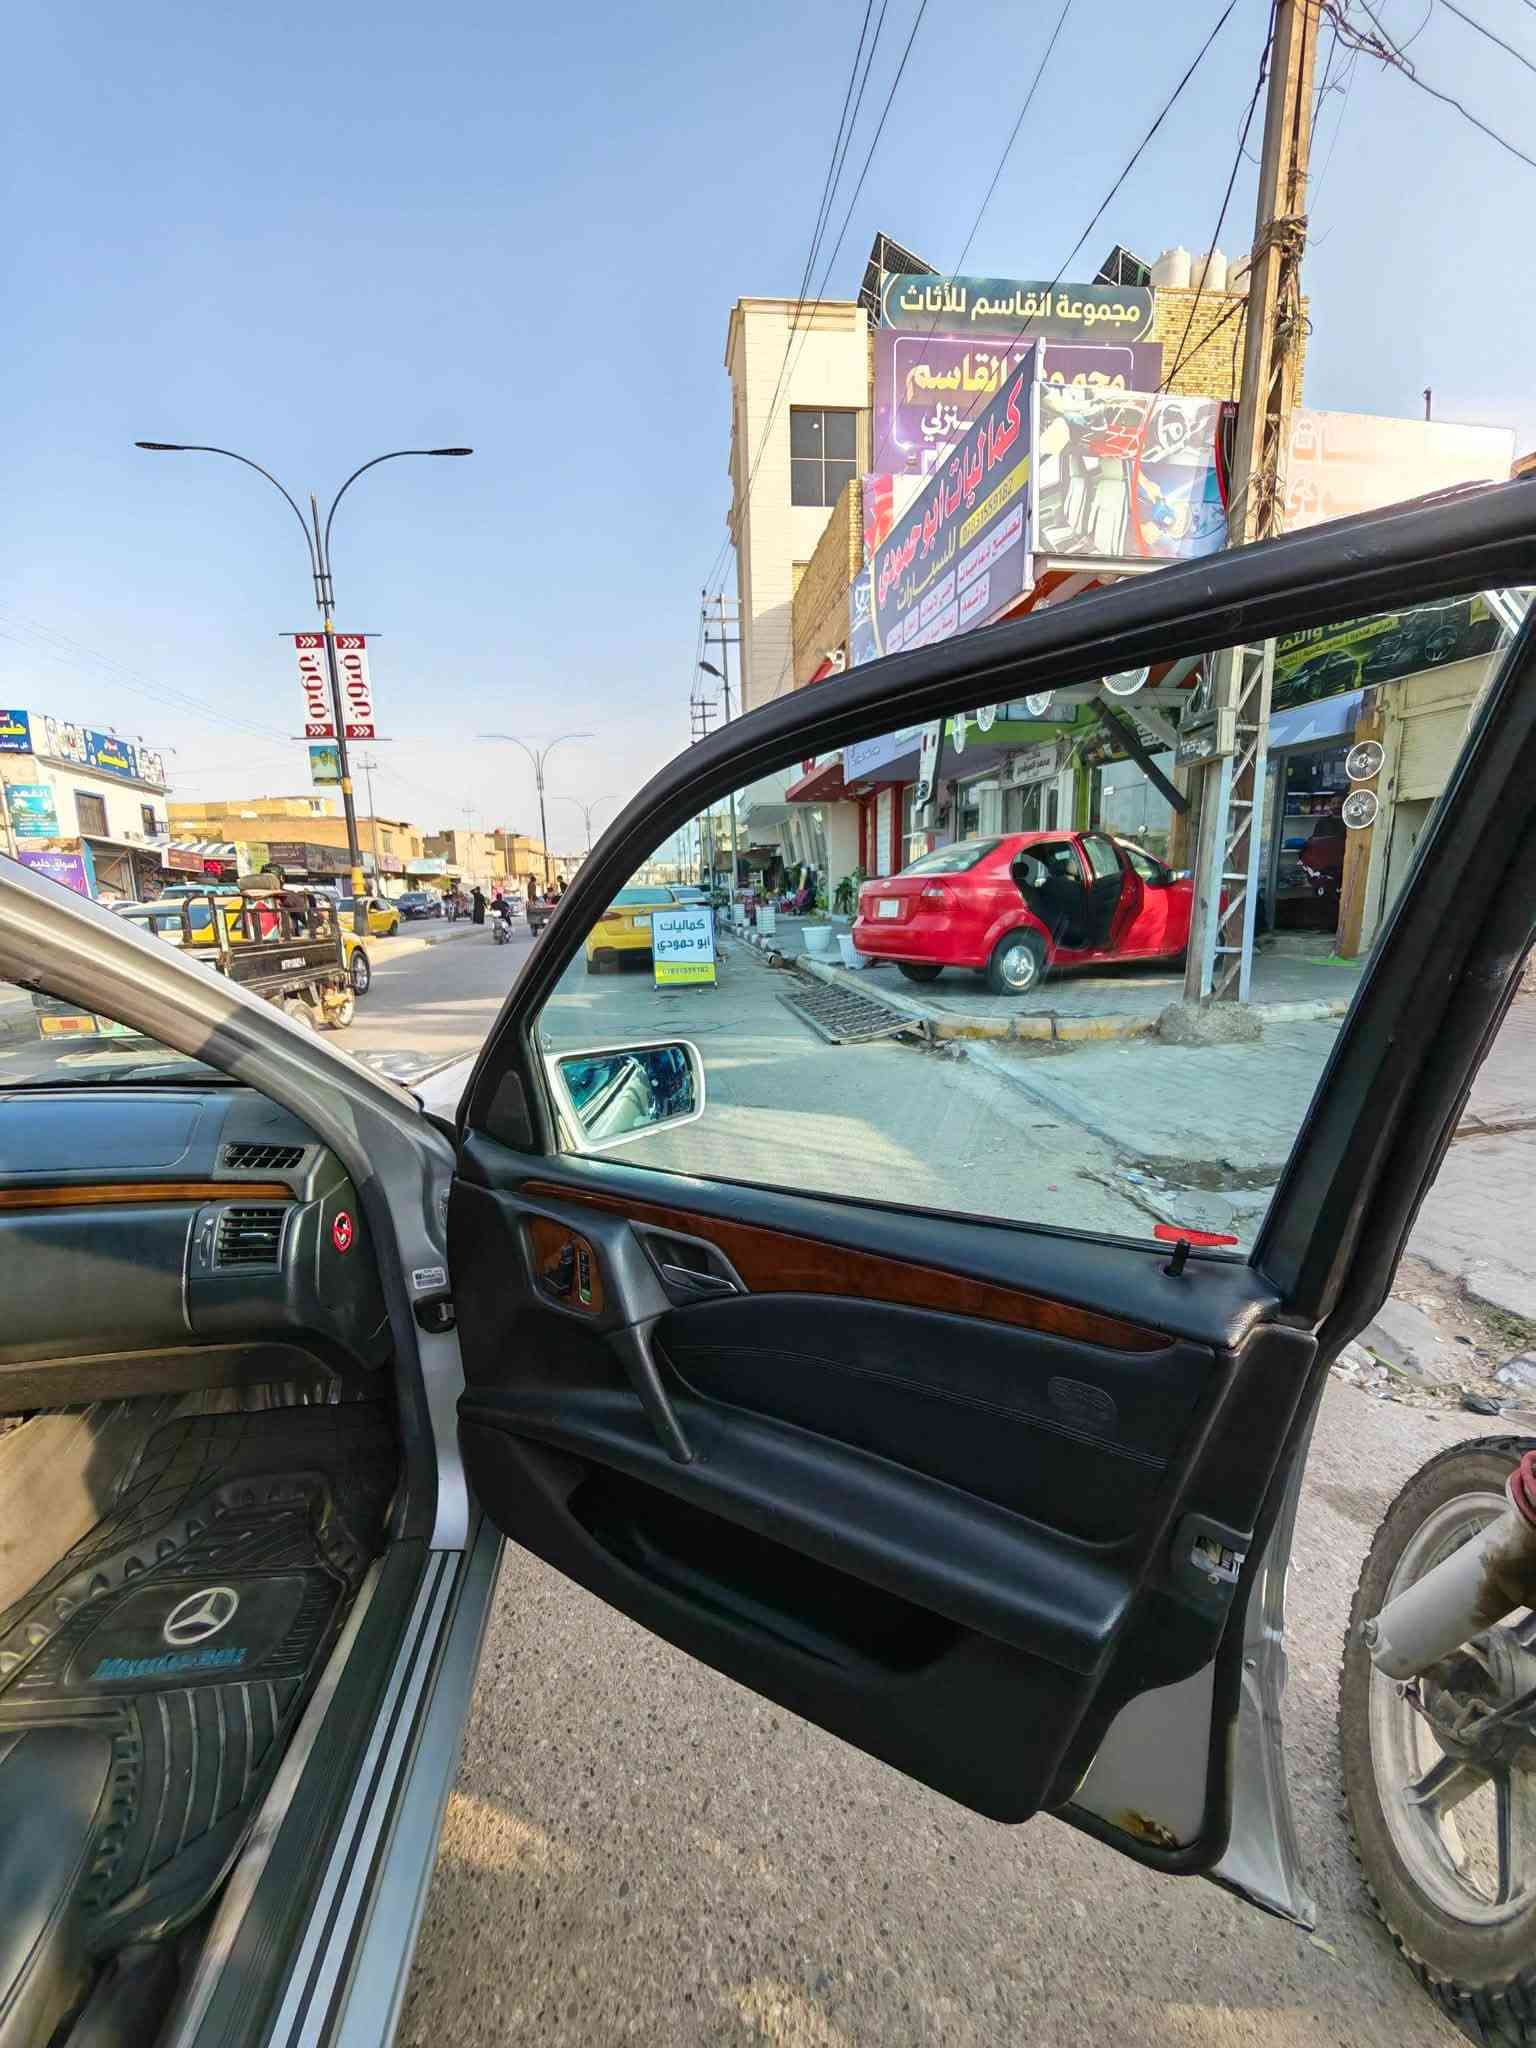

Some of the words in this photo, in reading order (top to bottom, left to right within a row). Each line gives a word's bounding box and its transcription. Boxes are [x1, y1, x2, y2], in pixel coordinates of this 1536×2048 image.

[900, 280, 966, 313] للأثاث
[1056, 294, 1140, 327] مجموعة
[660, 919, 706, 933] كماليات
[657, 939, 694, 954] حمودي
